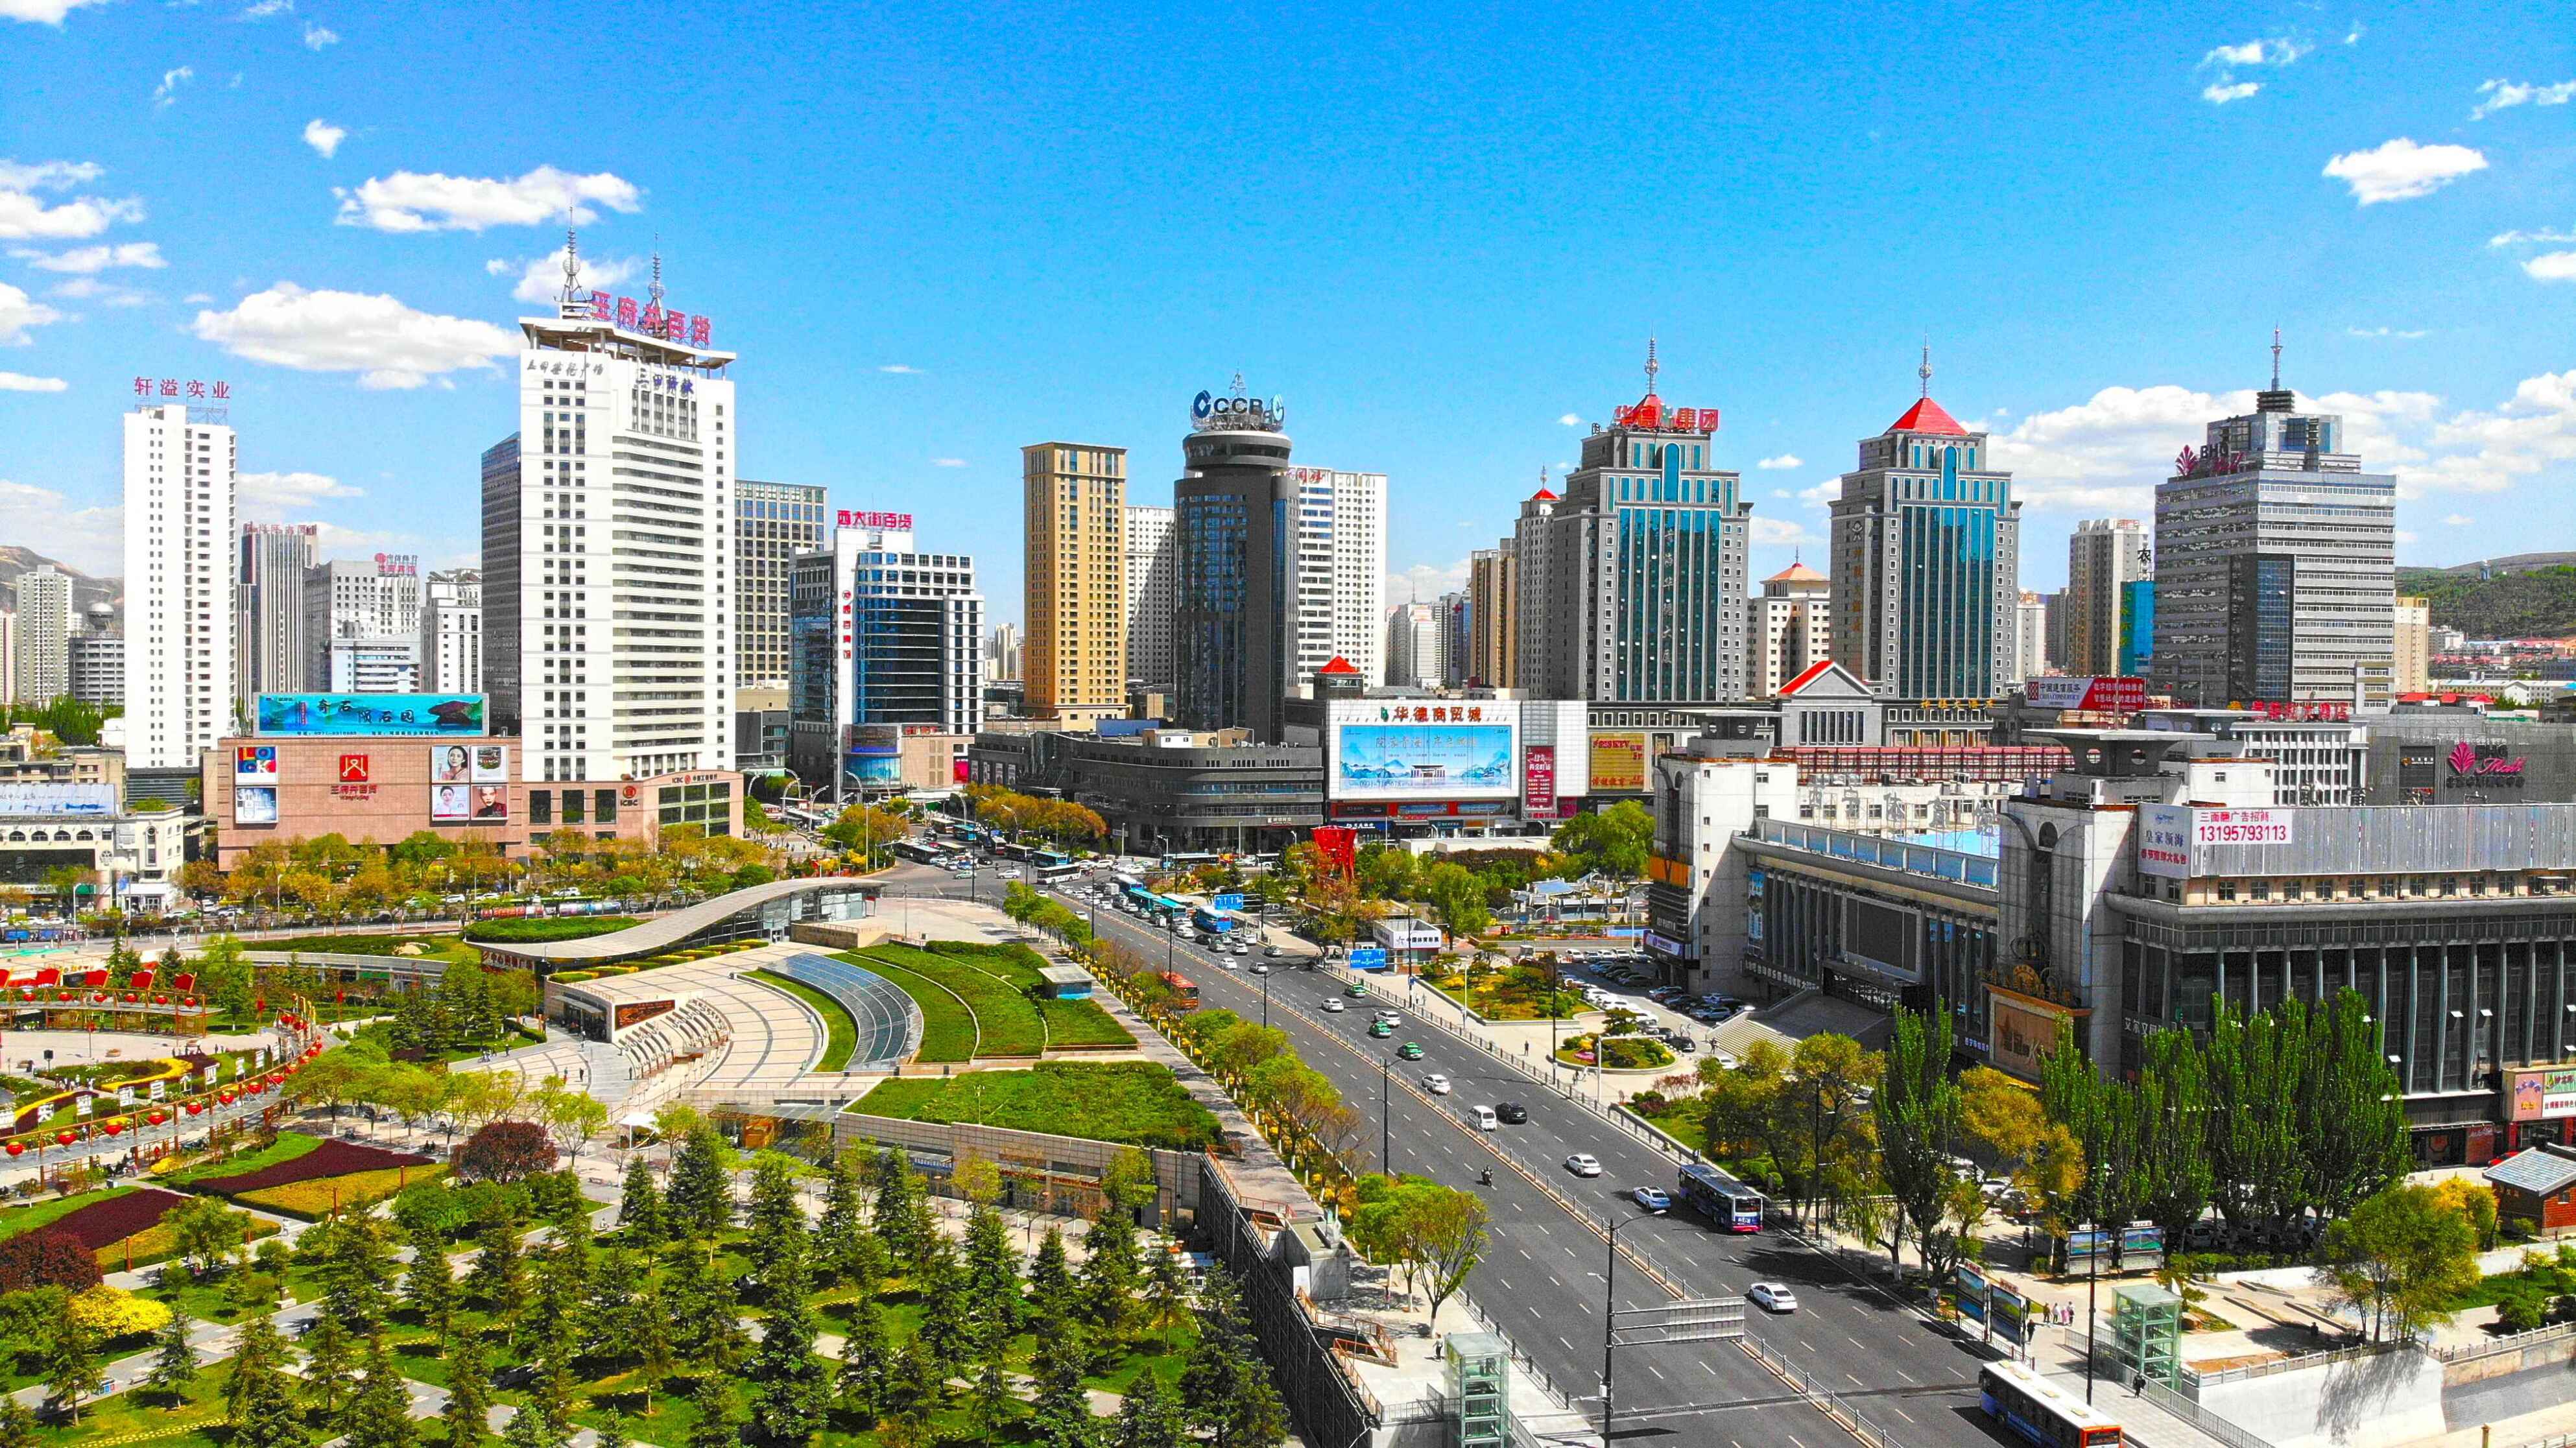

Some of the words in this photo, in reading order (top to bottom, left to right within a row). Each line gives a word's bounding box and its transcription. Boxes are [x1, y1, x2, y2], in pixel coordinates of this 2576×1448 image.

[591, 290, 711, 344] 王府井百货
[134, 376, 230, 399] 轩溢实业
[1213, 397, 1263, 415] CCB
[837, 510, 912, 528] 西大街百货
[1393, 706, 1483, 722] 华德商贸城
[1809, 785, 1995, 837] 西宁体育馆
[2199, 825, 2286, 841] 13195793113
